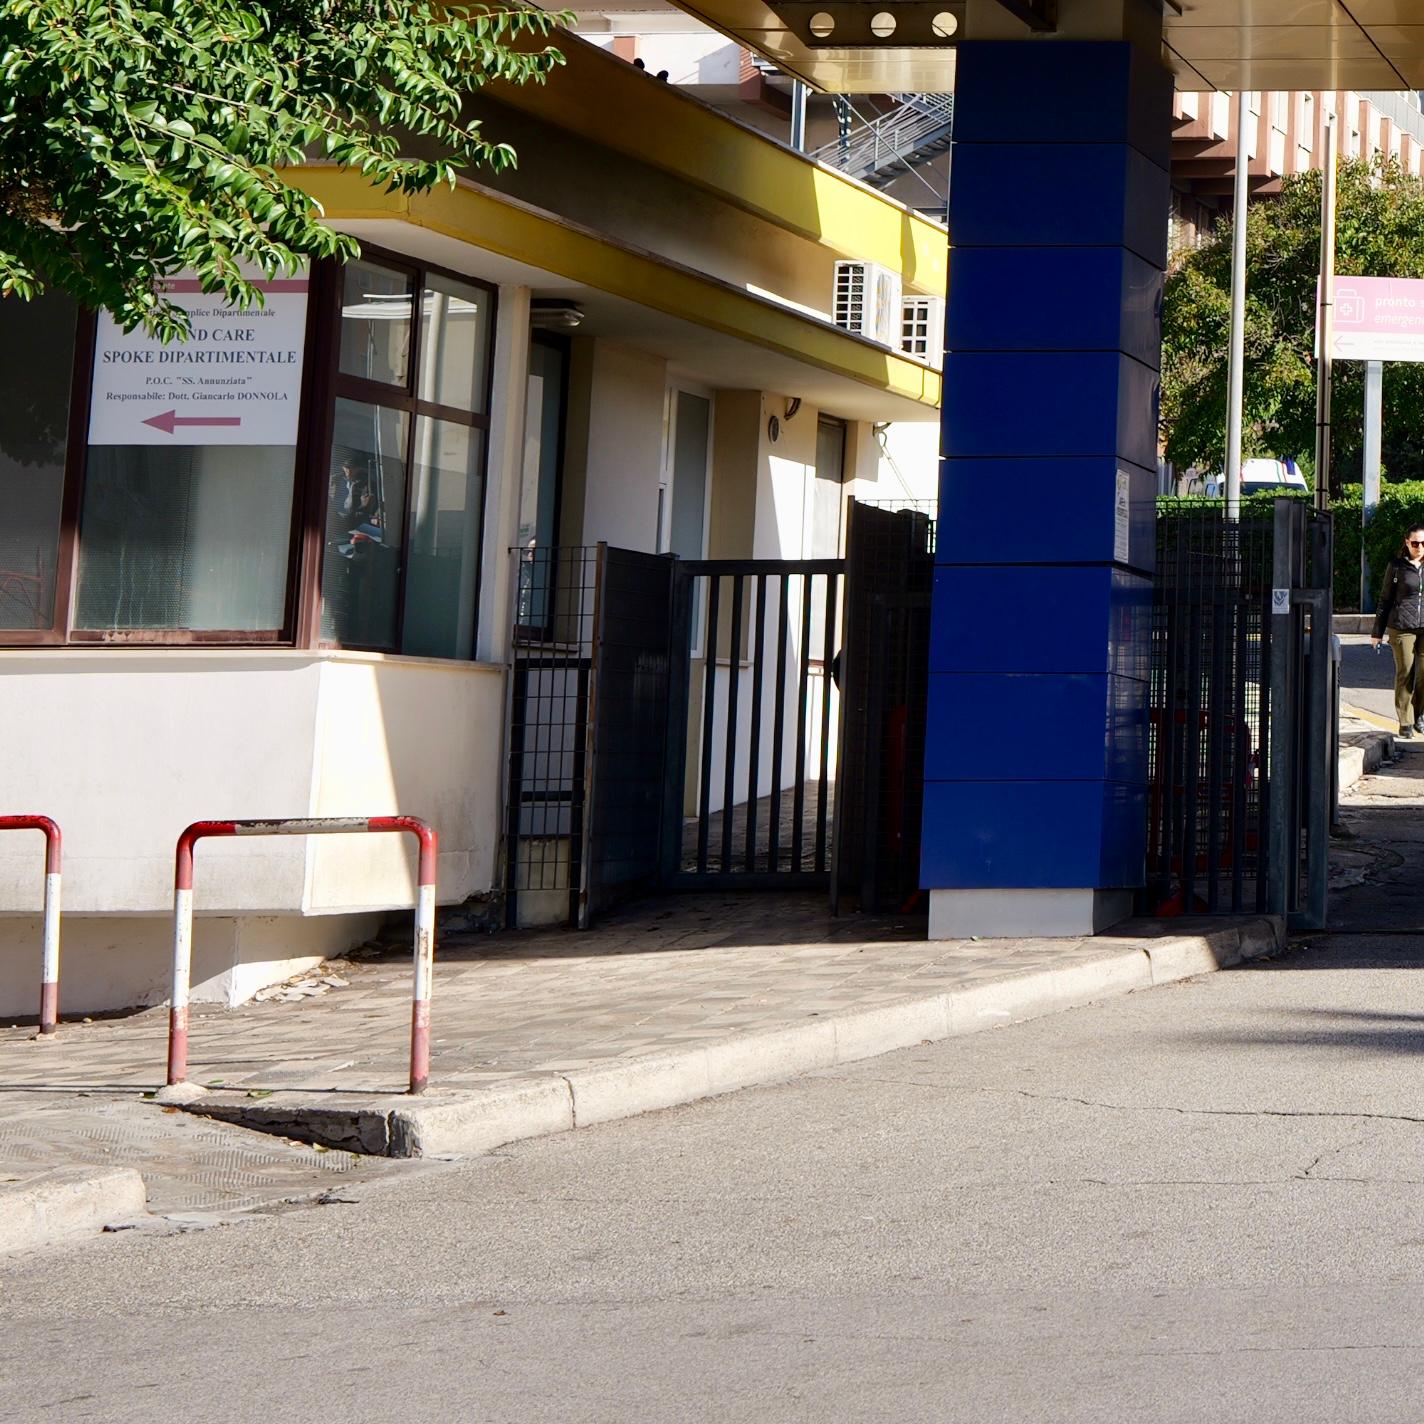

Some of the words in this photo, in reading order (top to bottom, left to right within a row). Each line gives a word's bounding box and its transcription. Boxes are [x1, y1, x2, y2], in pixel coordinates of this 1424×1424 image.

[1375, 297, 1416, 309] pronto
[212, 328, 256, 342] CARE
[103, 351, 154, 363] SPOKE
[159, 351, 297, 364] DIPARTIMENTALE
[106, 392, 166, 402] Responsabile:
[168, 392, 190, 401] Dott.
[192, 392, 234, 401] Giancarlo
[237, 392, 288, 401] DONNOLA
